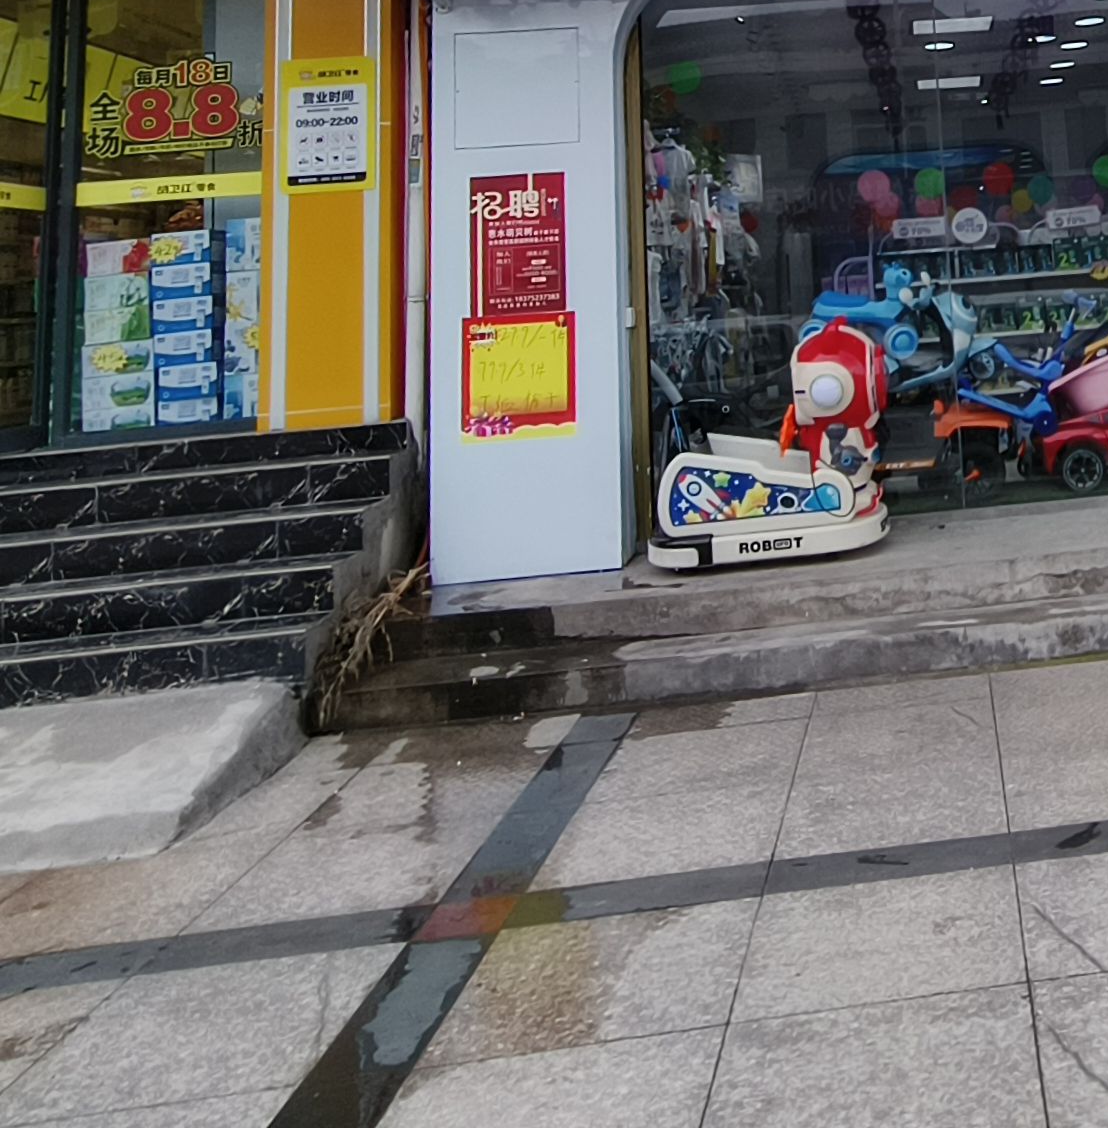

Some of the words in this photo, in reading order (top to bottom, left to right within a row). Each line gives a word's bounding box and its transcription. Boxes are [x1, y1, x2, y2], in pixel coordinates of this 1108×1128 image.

[135, 59, 232, 87] 每月18日
[303, 90, 354, 104] 营业时间
[296, 116, 358, 128] 09:00-22:00
[470, 190, 540, 220] 招聘
